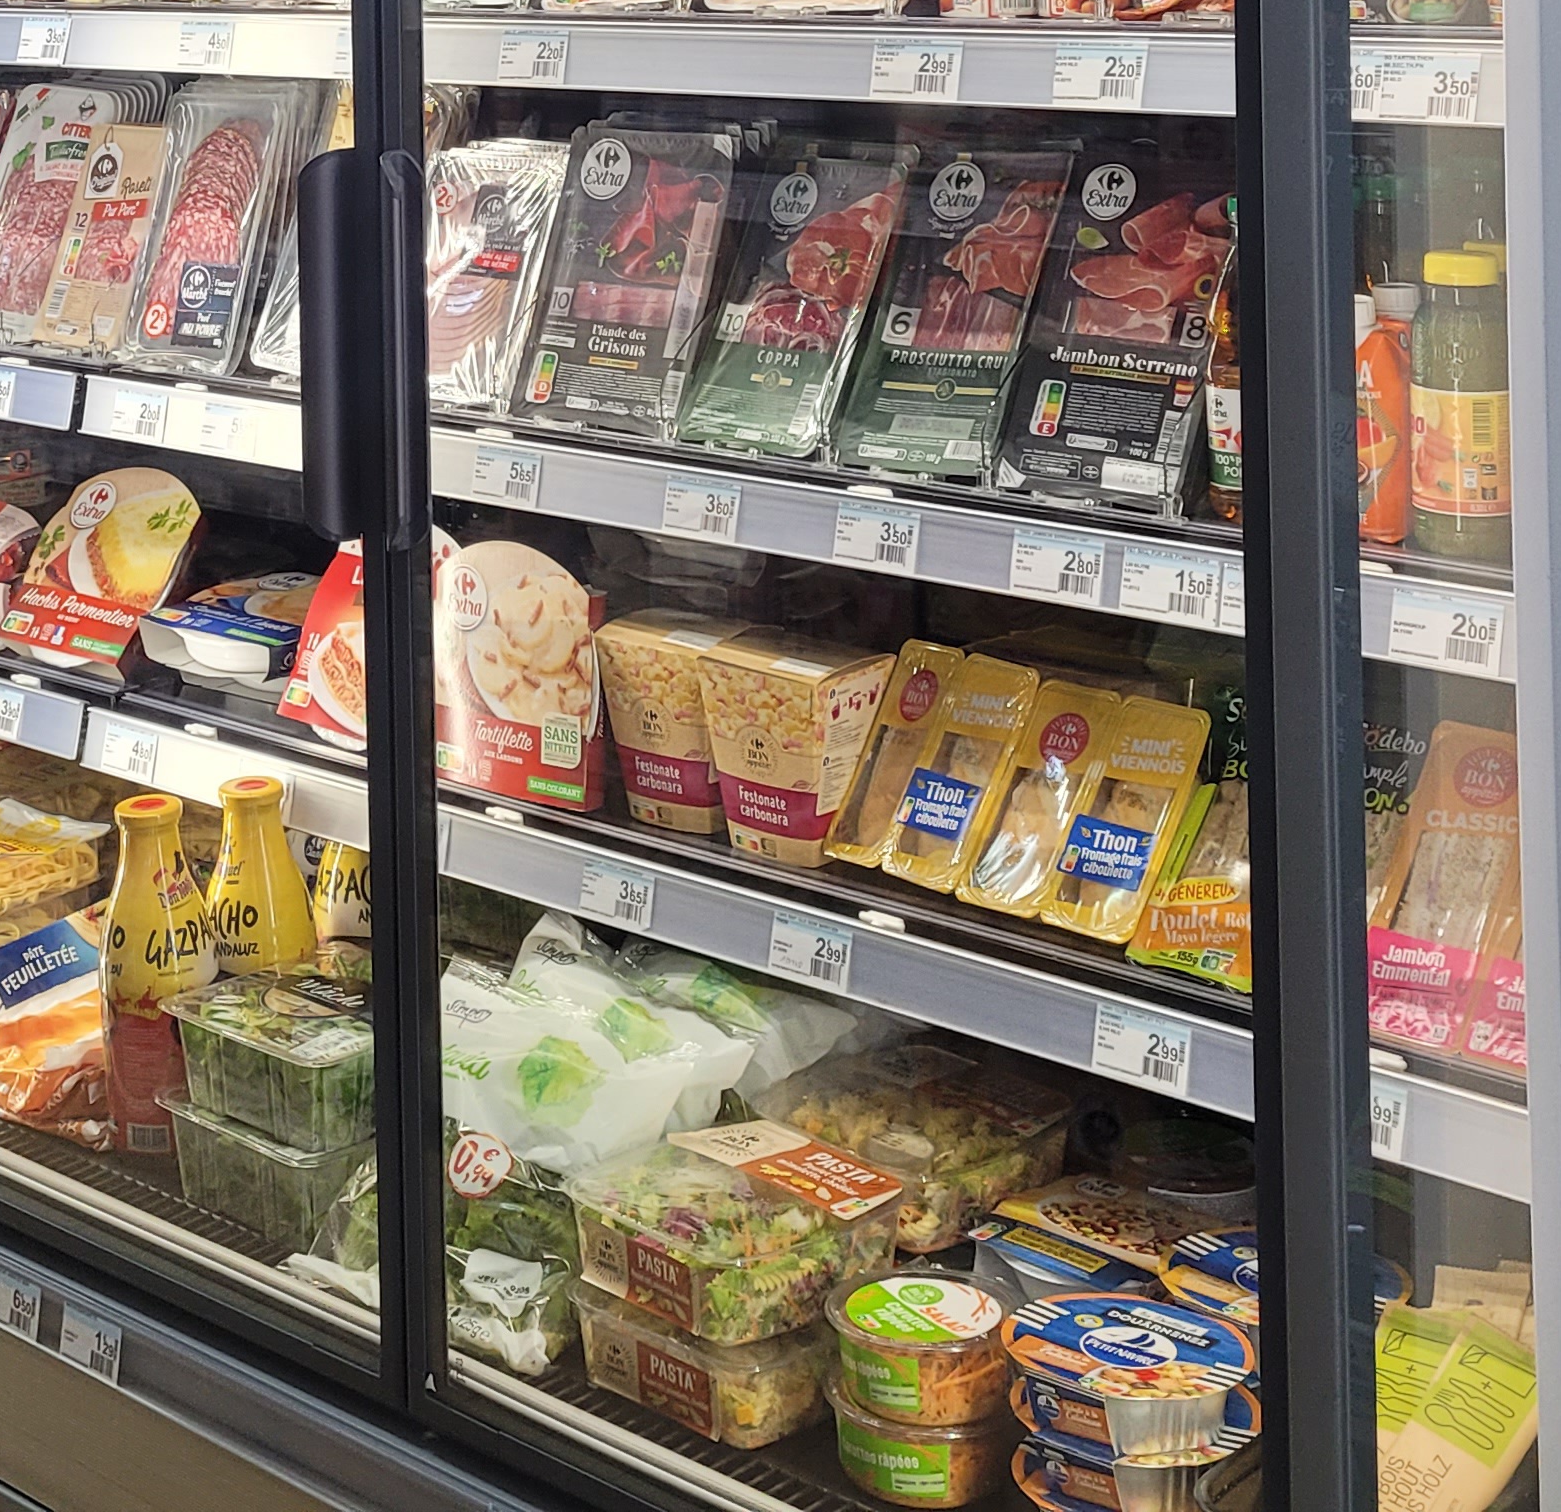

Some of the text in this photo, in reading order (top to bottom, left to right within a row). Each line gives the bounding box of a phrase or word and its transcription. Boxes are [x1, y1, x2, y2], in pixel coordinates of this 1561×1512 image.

[919, 53, 947, 74] 2€99
[1104, 56, 1135, 78] 2€20
[1433, 71, 1470, 96] 3€50
[583, 167, 627, 189] Extra
[772, 195, 811, 215] Extra
[934, 190, 978, 210] Extra
[1086, 188, 1131, 209] Extra
[75, 212, 89, 228] 12
[551, 291, 570, 311] 10
[592, 324, 647, 341] Viande des
[725, 314, 744, 333] 10
[890, 311, 912, 335] 6
[1185, 316, 1206, 341] 8
[587, 336, 647, 358] Grisons
[890, 349, 974, 367] PROSCIUTTO
[756, 349, 800, 369] COPPA
[1050, 345, 1121, 369] Jambon
[1122, 353, 1199, 378] Serrano
[73, 502, 106, 521] Extra
[705, 494, 731, 516] 3€60
[880, 521, 908, 545] 3€50
[1063, 550, 1094, 576] 2€80
[1174, 569, 1206, 596] 1€50
[20, 587, 136, 629] Hachis Parmentier
[72, 637, 94, 650] SANS
[473, 719, 534, 752] Tartiflette
[543, 724, 579, 745] SANS
[543, 740, 579, 757] NITRITE
[747, 745, 770, 761] BON
[1131, 738, 1173, 756] MINI
[634, 756, 681, 779] Festonate
[1110, 753, 1187, 775] VIENNOIS
[636, 771, 684, 796] carbonara
[1464, 769, 1507, 790] BON
[737, 785, 788, 811] Festonate
[925, 780, 967, 805] Thon
[739, 803, 789, 827] carbonara
[915, 798, 968, 819] Fromage frais
[914, 813, 959, 832] ciboulette
[1091, 827, 1139, 853] Thon
[1080, 847, 1143, 868] Fromage frais
[1082, 862, 1134, 880] ciboulette
[1167, 881, 1238, 902] GÉNÉREUX
[1151, 908, 1221, 934] Poulet
[1164, 928, 1200, 946] Mayo
[22, 944, 46, 962] PÂTE
[814, 936, 842, 963] 2€99
[1381, 943, 1446, 968] Jambon
[0, 942, 80, 996] FEUILLETÉE
[1372, 961, 1450, 987] Emmental
[1147, 1033, 1178, 1062] 2€99
[1107, 1309, 1211, 1348] DOUARNENEZ
[1115, 1346, 1159, 1366] NAVIRE
[1392, 1461, 1424, 1506] HOUT
[1423, 1454, 1453, 1496] HOLZ
